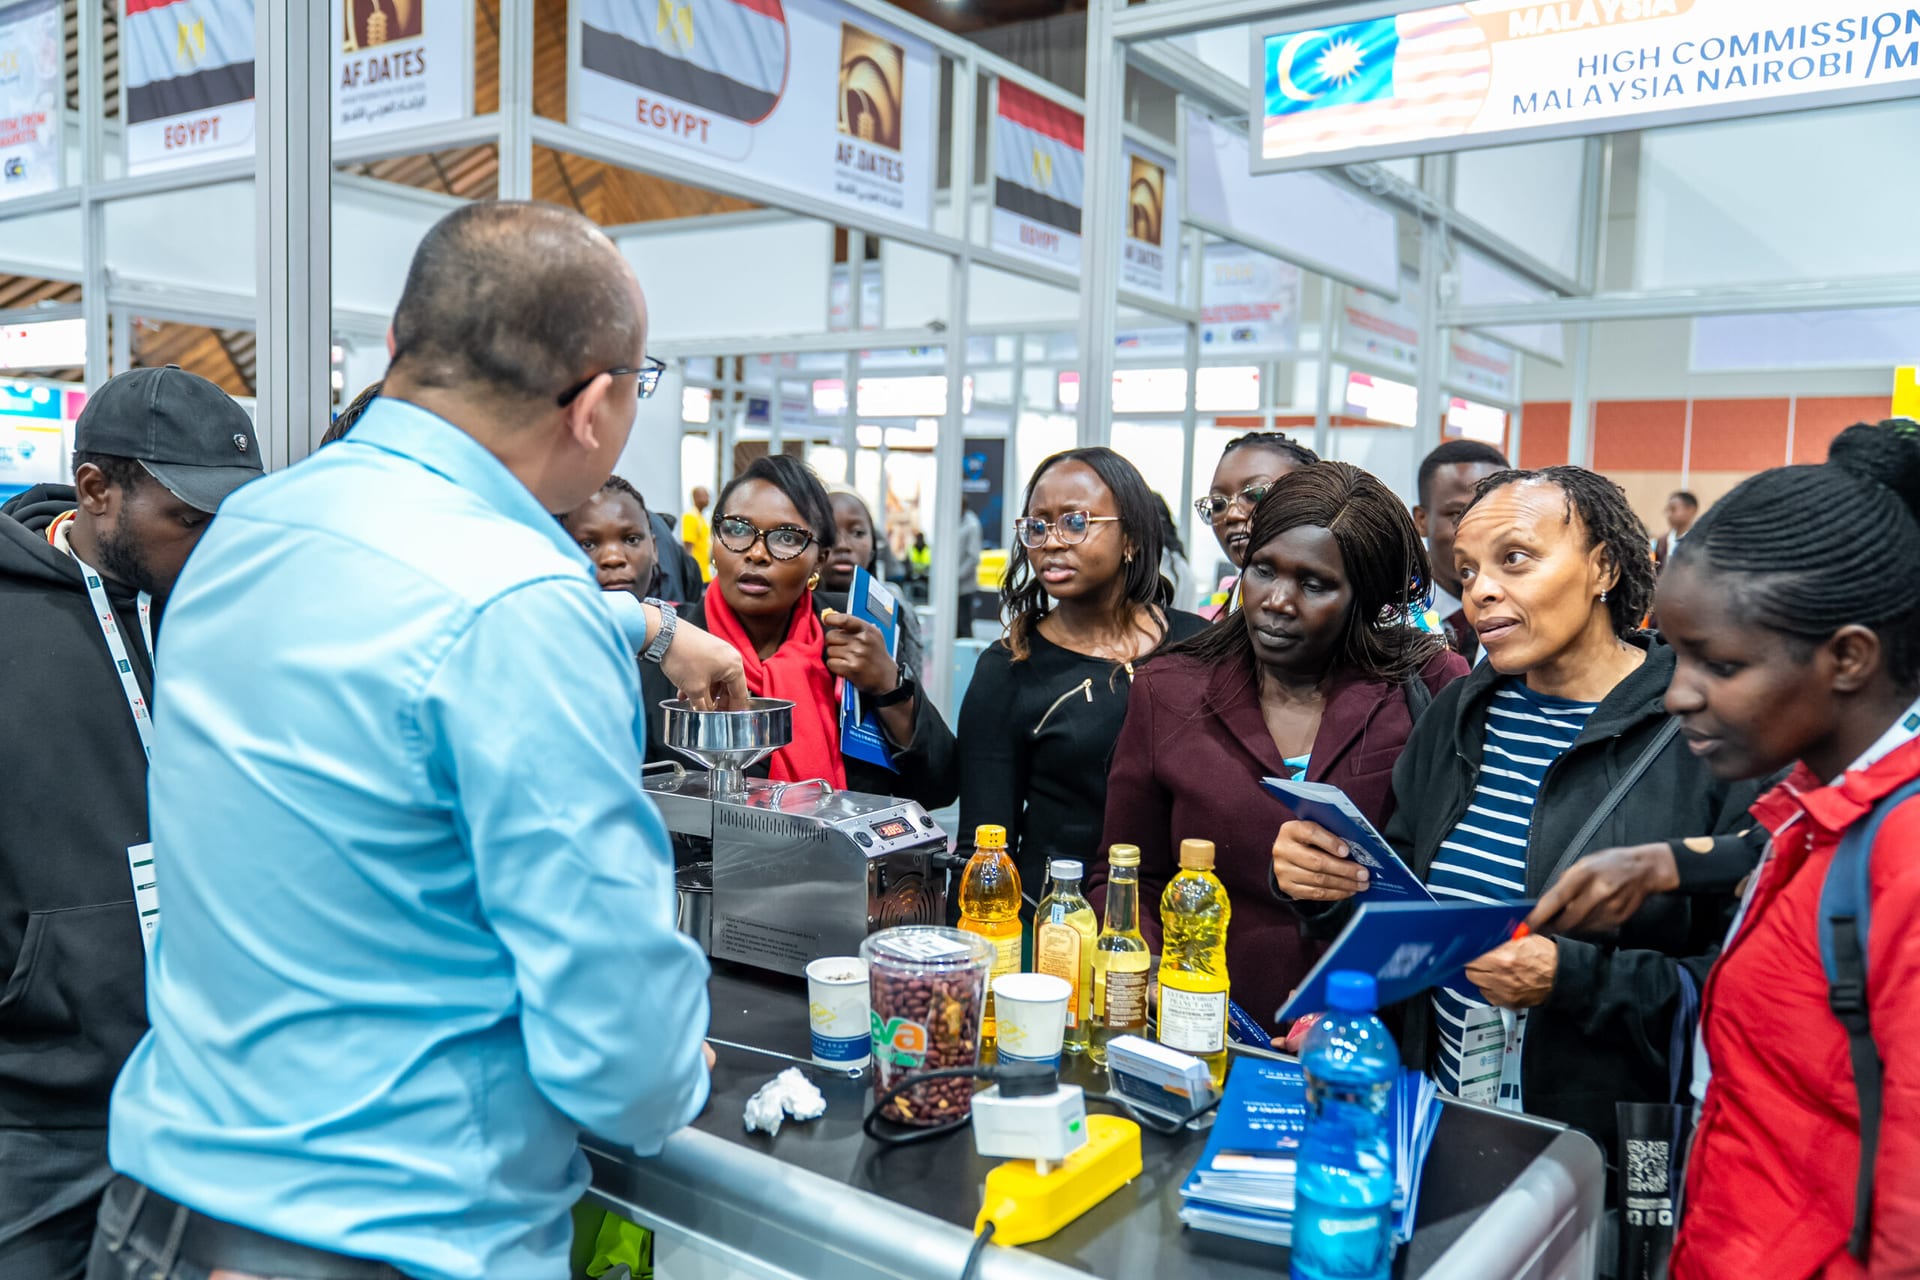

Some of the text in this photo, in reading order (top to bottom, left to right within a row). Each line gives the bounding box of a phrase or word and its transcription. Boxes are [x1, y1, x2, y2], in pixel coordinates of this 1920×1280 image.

[1578, 8, 1920, 78] HIGH COMMISSION
[341, 47, 425, 89] AF.DATES
[1513, 73, 1684, 115] MALAYSIA
[1697, 50, 1853, 92] NAIROBI
[164, 116, 221, 149] EGYPT
[637, 97, 710, 144] EGYPT
[835, 141, 904, 183] AF.DATES
